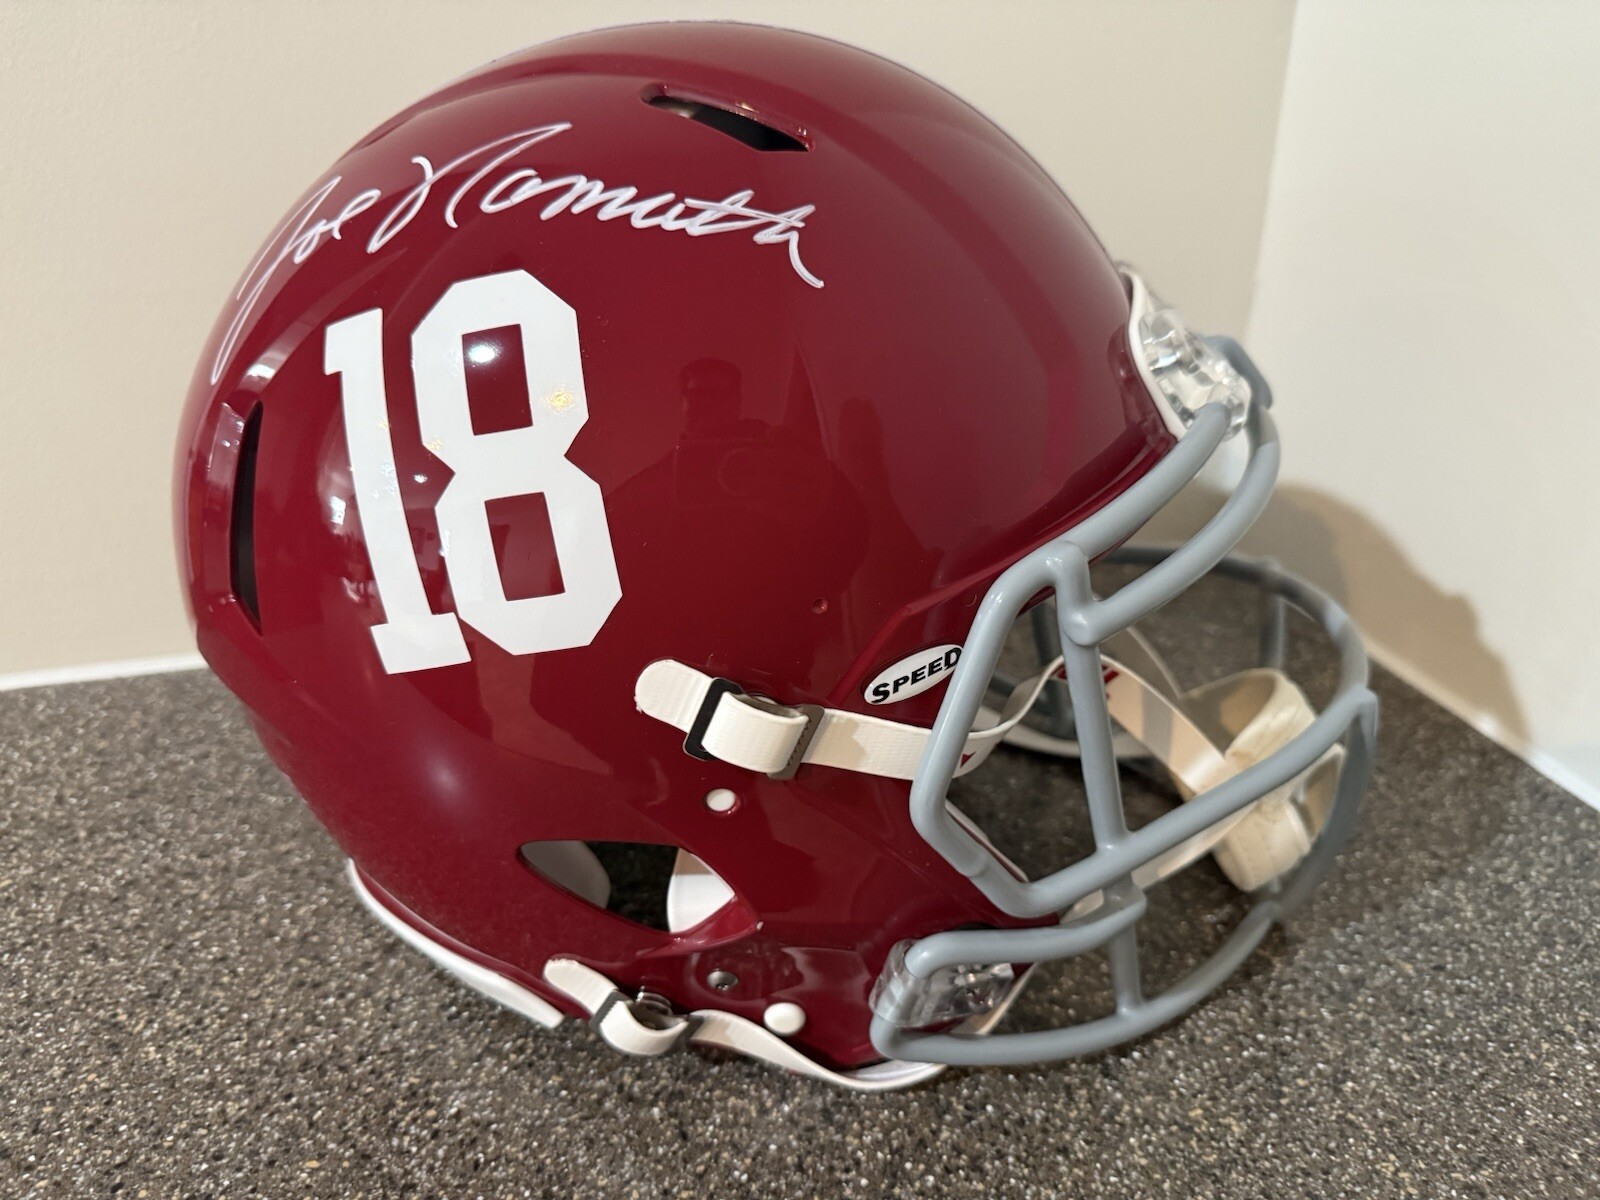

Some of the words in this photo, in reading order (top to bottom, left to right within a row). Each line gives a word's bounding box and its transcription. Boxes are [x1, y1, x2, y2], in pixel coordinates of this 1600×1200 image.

[210, 175, 382, 386] Joe
[323, 268, 623, 675] 18
[870, 646, 963, 704] SPEED
